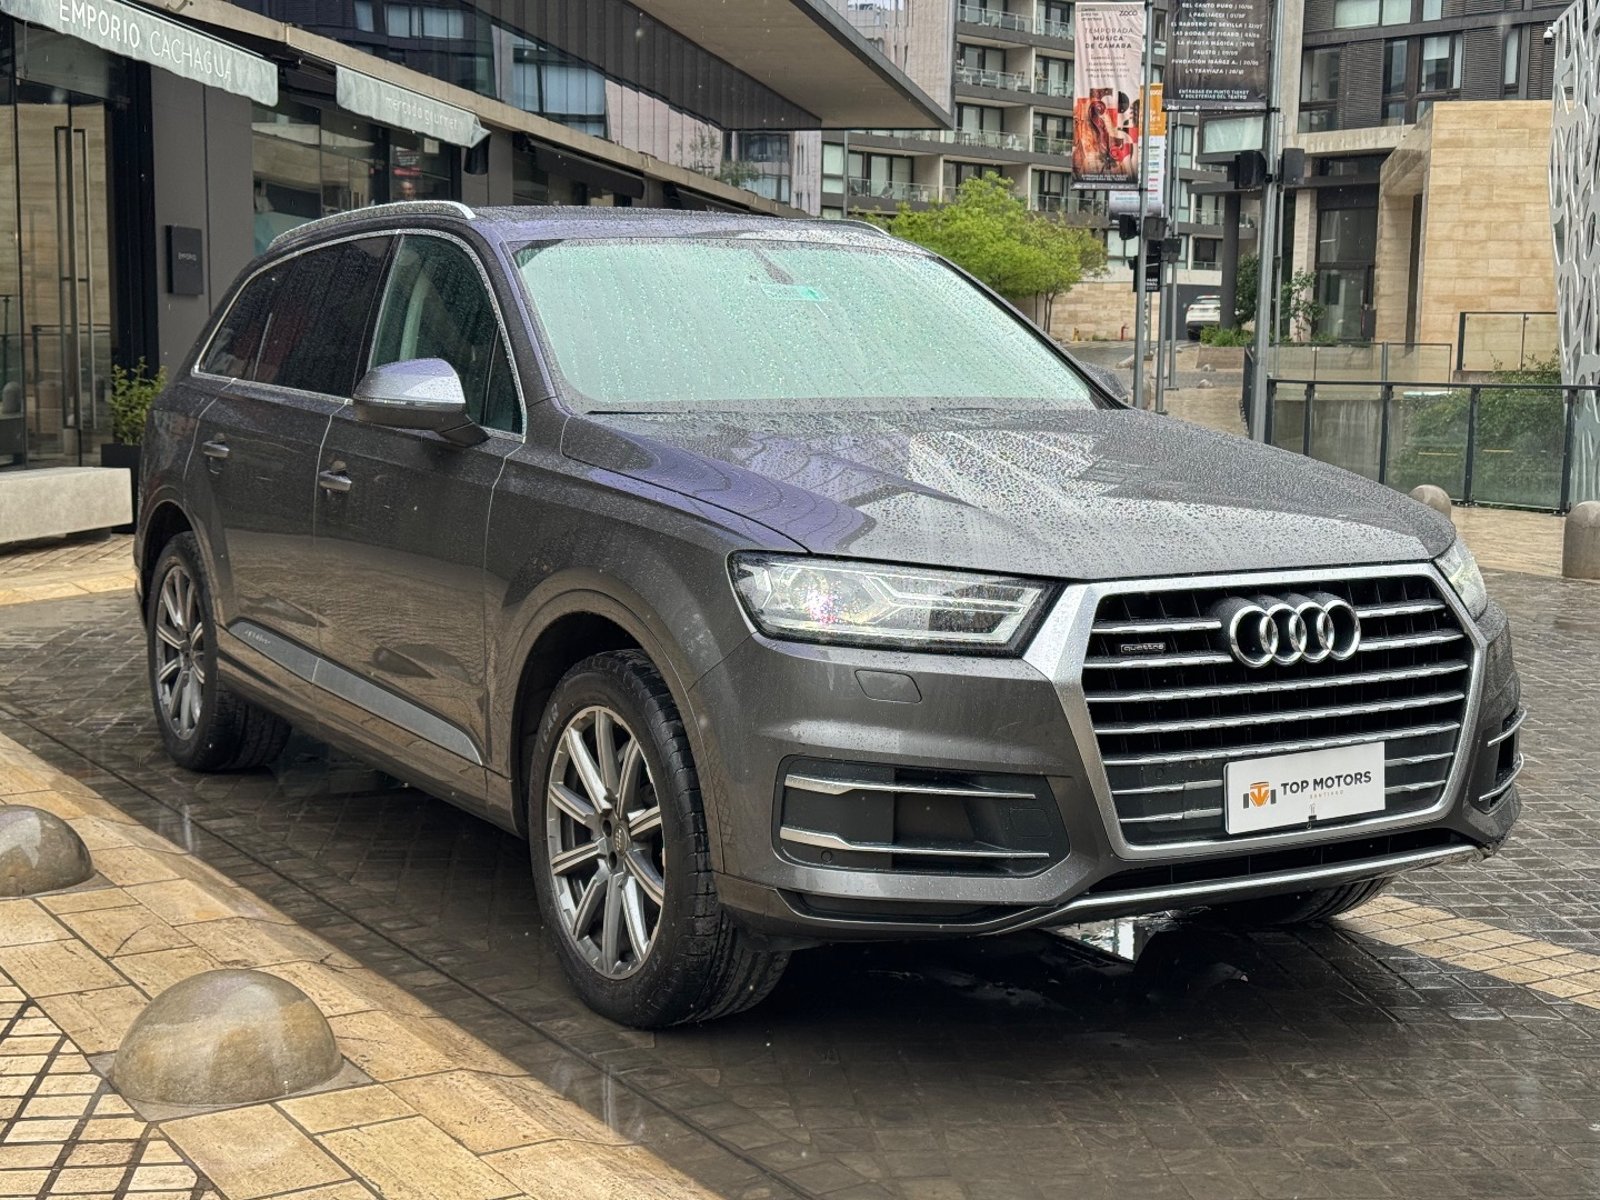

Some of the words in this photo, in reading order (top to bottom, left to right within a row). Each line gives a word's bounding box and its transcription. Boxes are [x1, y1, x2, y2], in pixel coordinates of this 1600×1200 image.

[59, 0, 141, 48] EMPORIO
[150, 30, 232, 82] CACHAGUA
[1281, 780, 1309, 796] TOP
[1313, 771, 1372, 792] MOTORS
